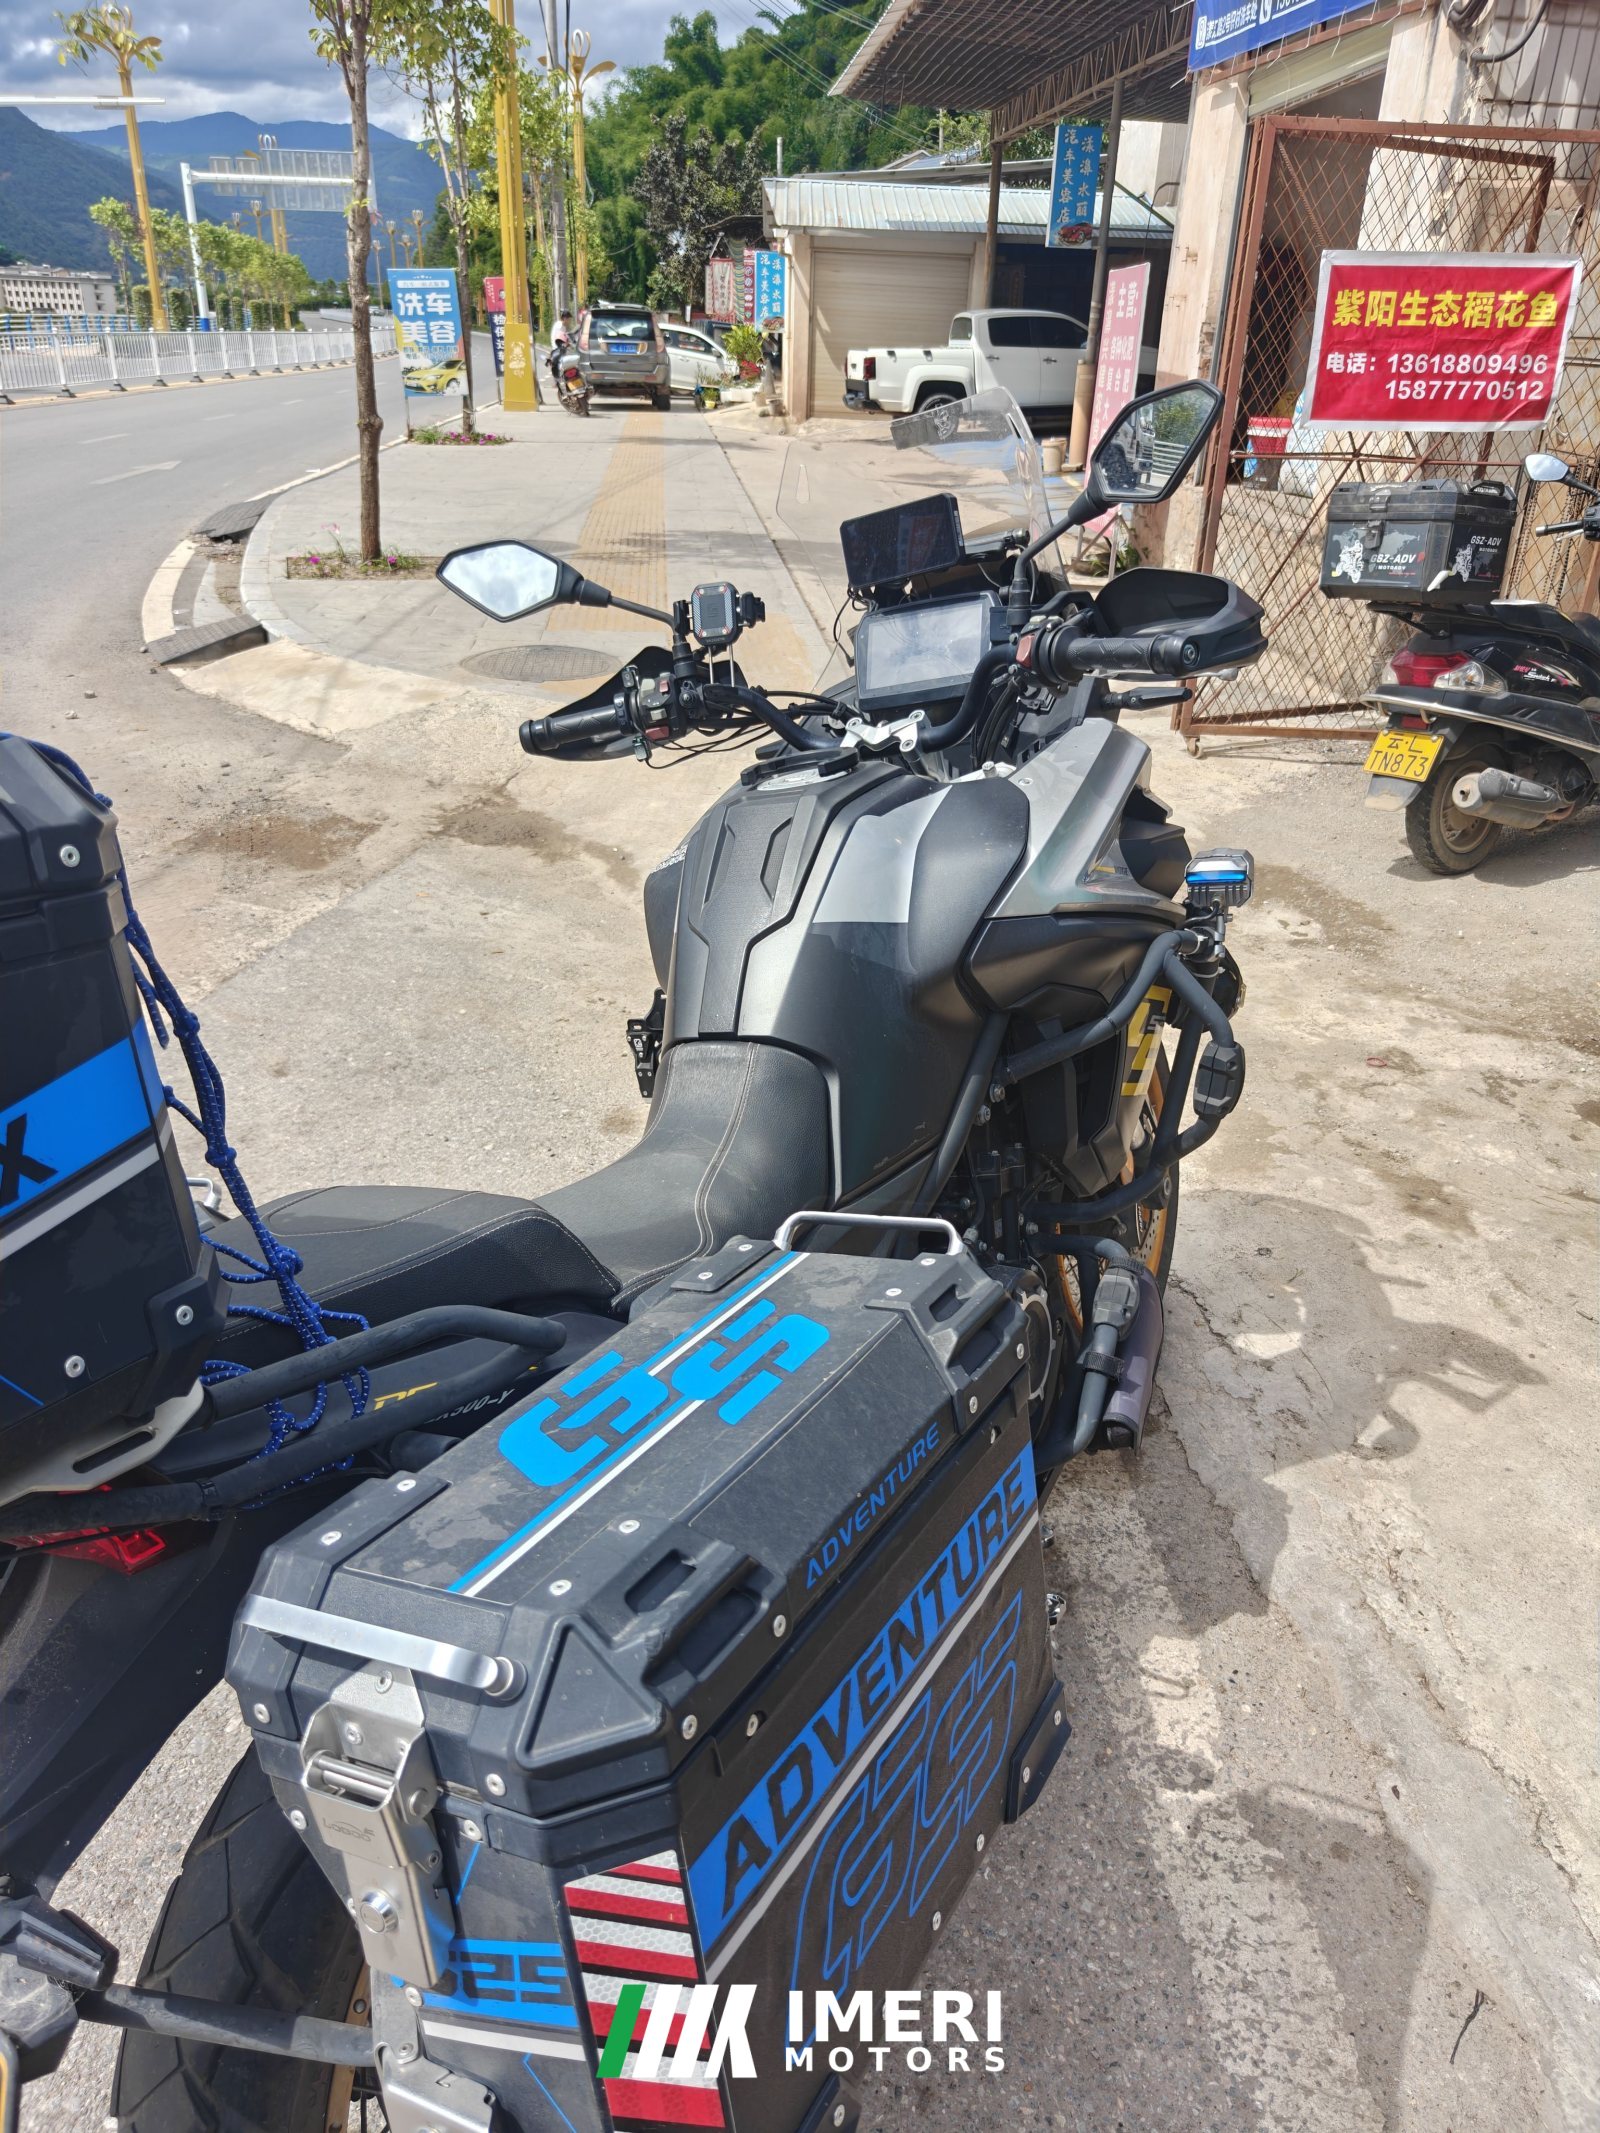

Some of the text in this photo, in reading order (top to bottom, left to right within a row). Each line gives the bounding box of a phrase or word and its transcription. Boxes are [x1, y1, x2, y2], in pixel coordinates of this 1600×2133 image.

[1057, 129, 1079, 223] 汽车美容店
[396, 292, 453, 316] 洗车
[1332, 289, 1559, 329] 紫阳生态稻花鱼
[401, 320, 457, 344] 美容
[1387, 353, 1548, 375] 13618809496
[1385, 380, 1545, 401] 15877770512
[1470, 535, 1502, 546] GSZ-ADV
[1371, 553, 1416, 564] GSZ-ADV
[1367, 750, 1430, 777] TN873
[805, 1422, 942, 1591] ADVENTURE
[722, 1455, 1032, 1919] ADVENTURE
